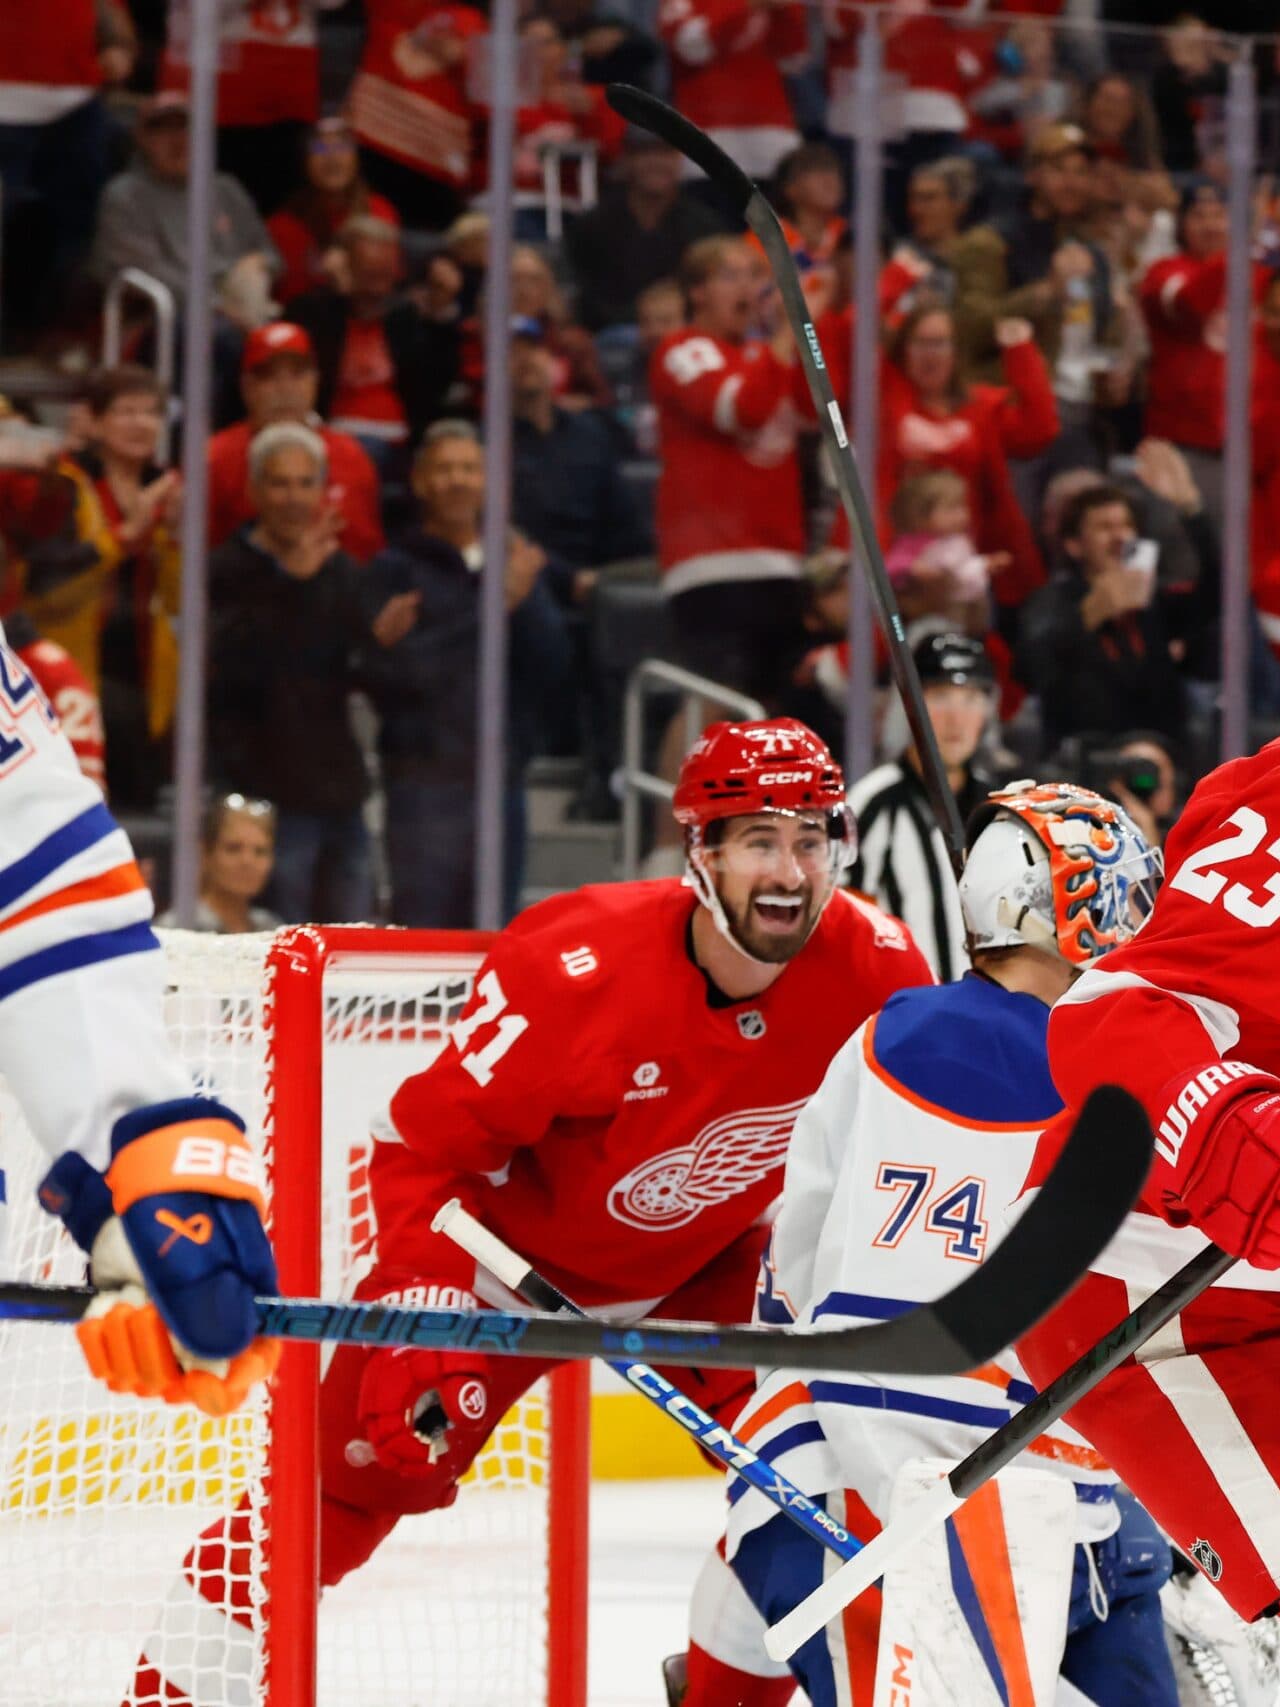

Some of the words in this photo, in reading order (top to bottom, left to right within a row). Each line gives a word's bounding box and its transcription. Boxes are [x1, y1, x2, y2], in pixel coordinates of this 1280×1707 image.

[757, 771, 814, 786] CCM
[560, 946, 598, 977] 10
[450, 968, 530, 1089] 71
[871, 1161, 989, 1265] 74
[626, 1363, 759, 1470] CCM
[764, 1474, 815, 1512] XF
[812, 1510, 850, 1543] PRO
